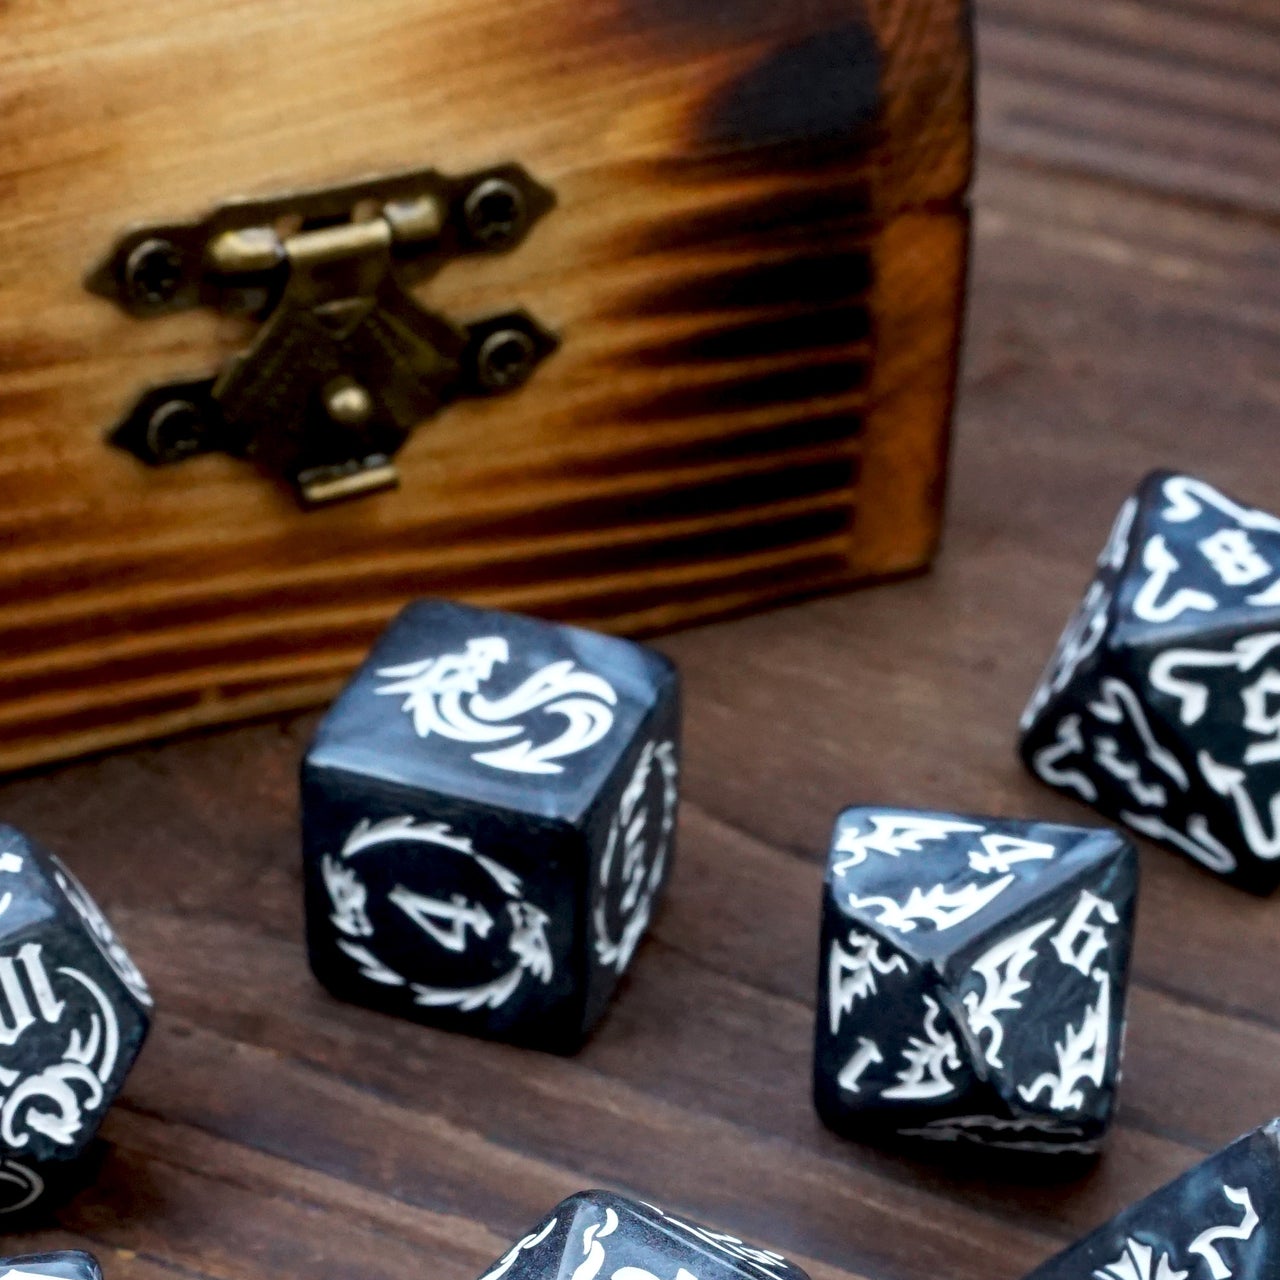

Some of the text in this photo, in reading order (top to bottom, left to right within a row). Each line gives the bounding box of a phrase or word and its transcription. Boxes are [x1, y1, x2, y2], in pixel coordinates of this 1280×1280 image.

[1198, 528, 1274, 587] 8
[968, 834, 1056, 874] 4
[387, 883, 494, 952] 4
[1050, 889, 1119, 975] 6
[837, 1037, 885, 1092] 1
[1188, 1184, 1260, 1280] 2
